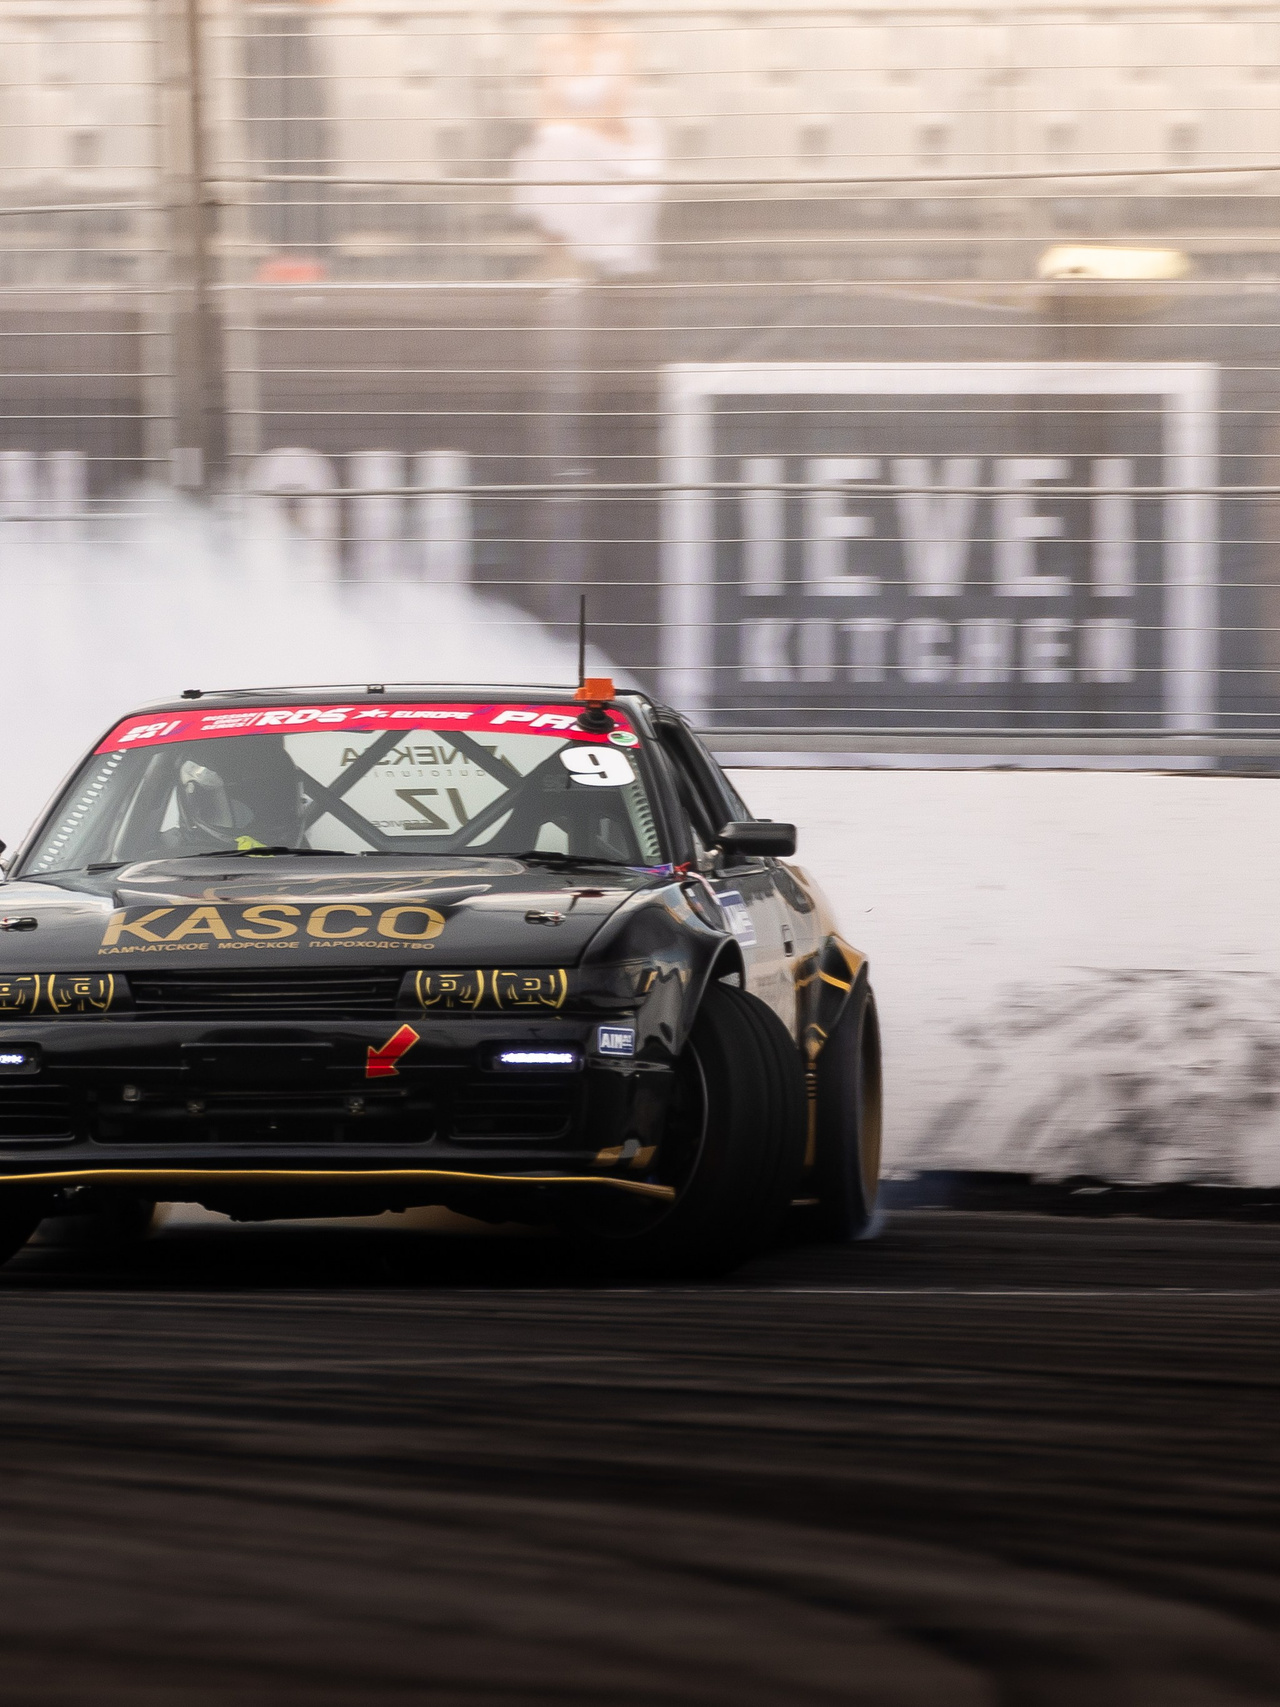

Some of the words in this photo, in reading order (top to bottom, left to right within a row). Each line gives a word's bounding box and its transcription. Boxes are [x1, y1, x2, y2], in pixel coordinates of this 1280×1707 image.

[255, 708, 354, 726] RDS
[389, 709, 474, 720] EUROPE
[489, 710, 620, 732] PR
[559, 746, 636, 787] 9
[101, 904, 446, 946] KASCO
[97, 942, 210, 955] КАМЧАТСКОЕ
[217, 941, 300, 950] МОРСКОЕ
[308, 940, 436, 950] ПАРОХОДСТВО
